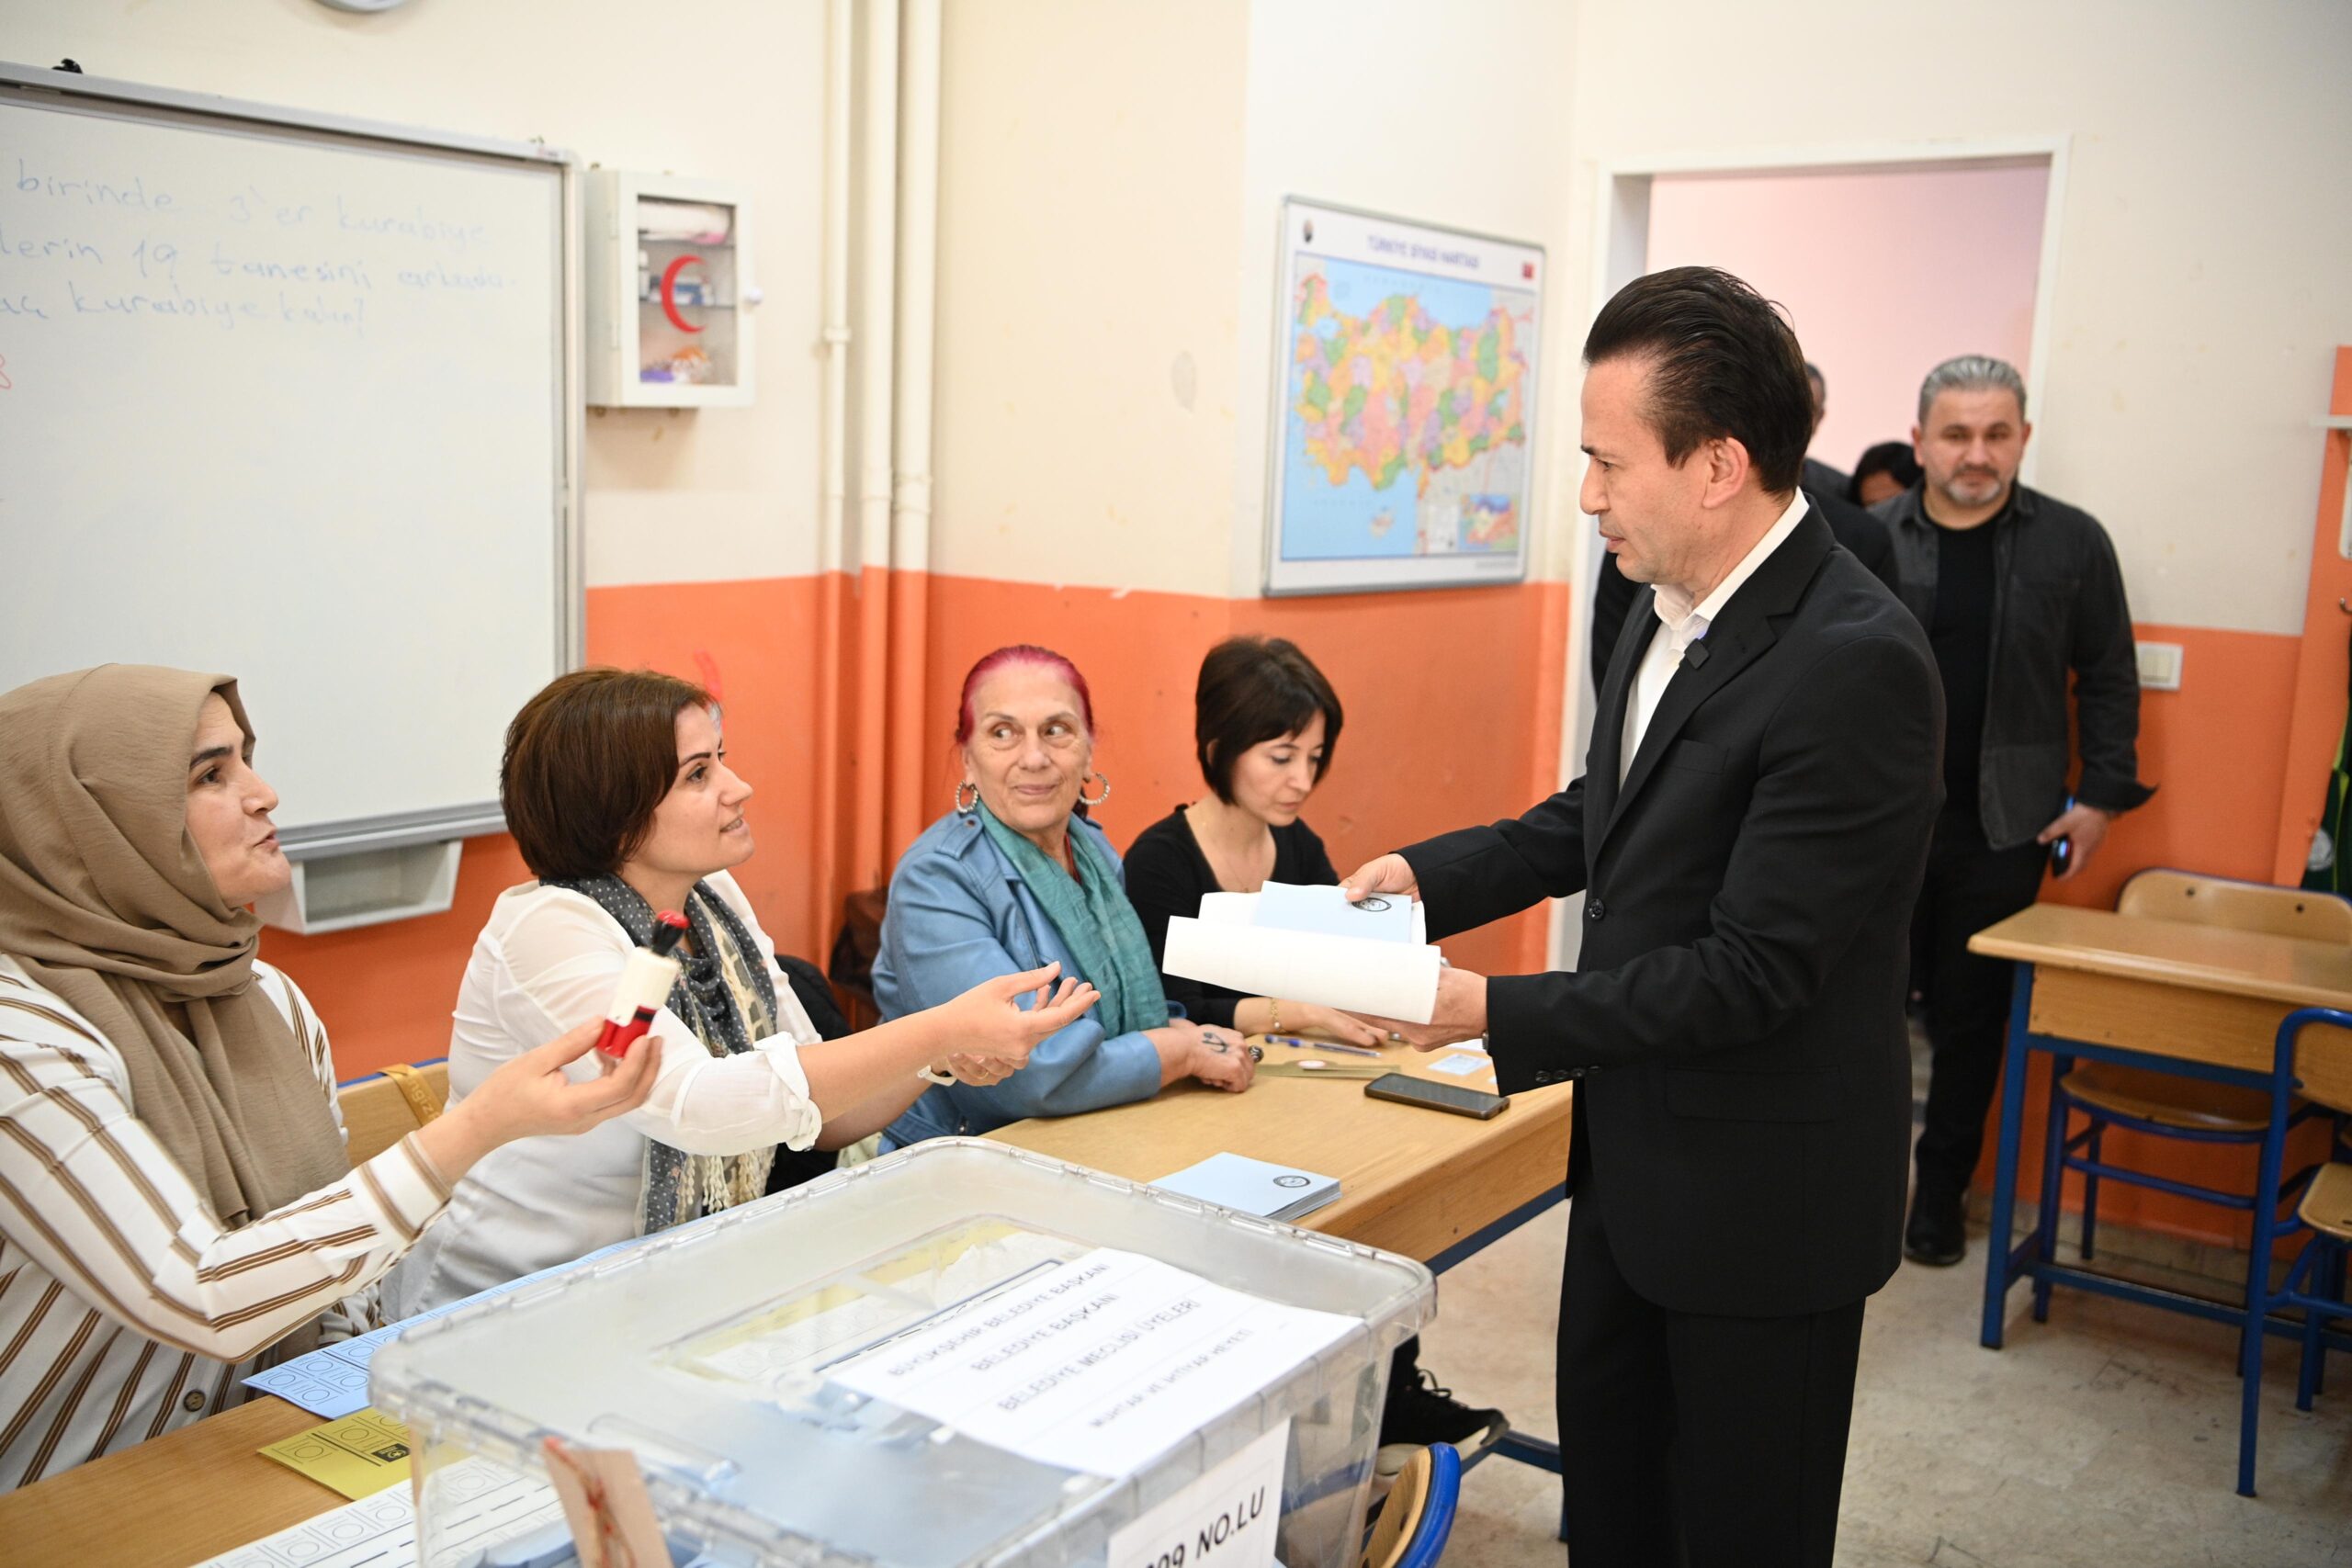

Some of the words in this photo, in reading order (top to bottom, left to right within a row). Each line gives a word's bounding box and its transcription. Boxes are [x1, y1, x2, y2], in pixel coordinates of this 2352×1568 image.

[17, 159, 182, 213] birinde
[132, 239, 178, 279] 19
[68, 280, 267, 330] kurabiye
[1196, 1484, 1265, 1561] NO.LU
